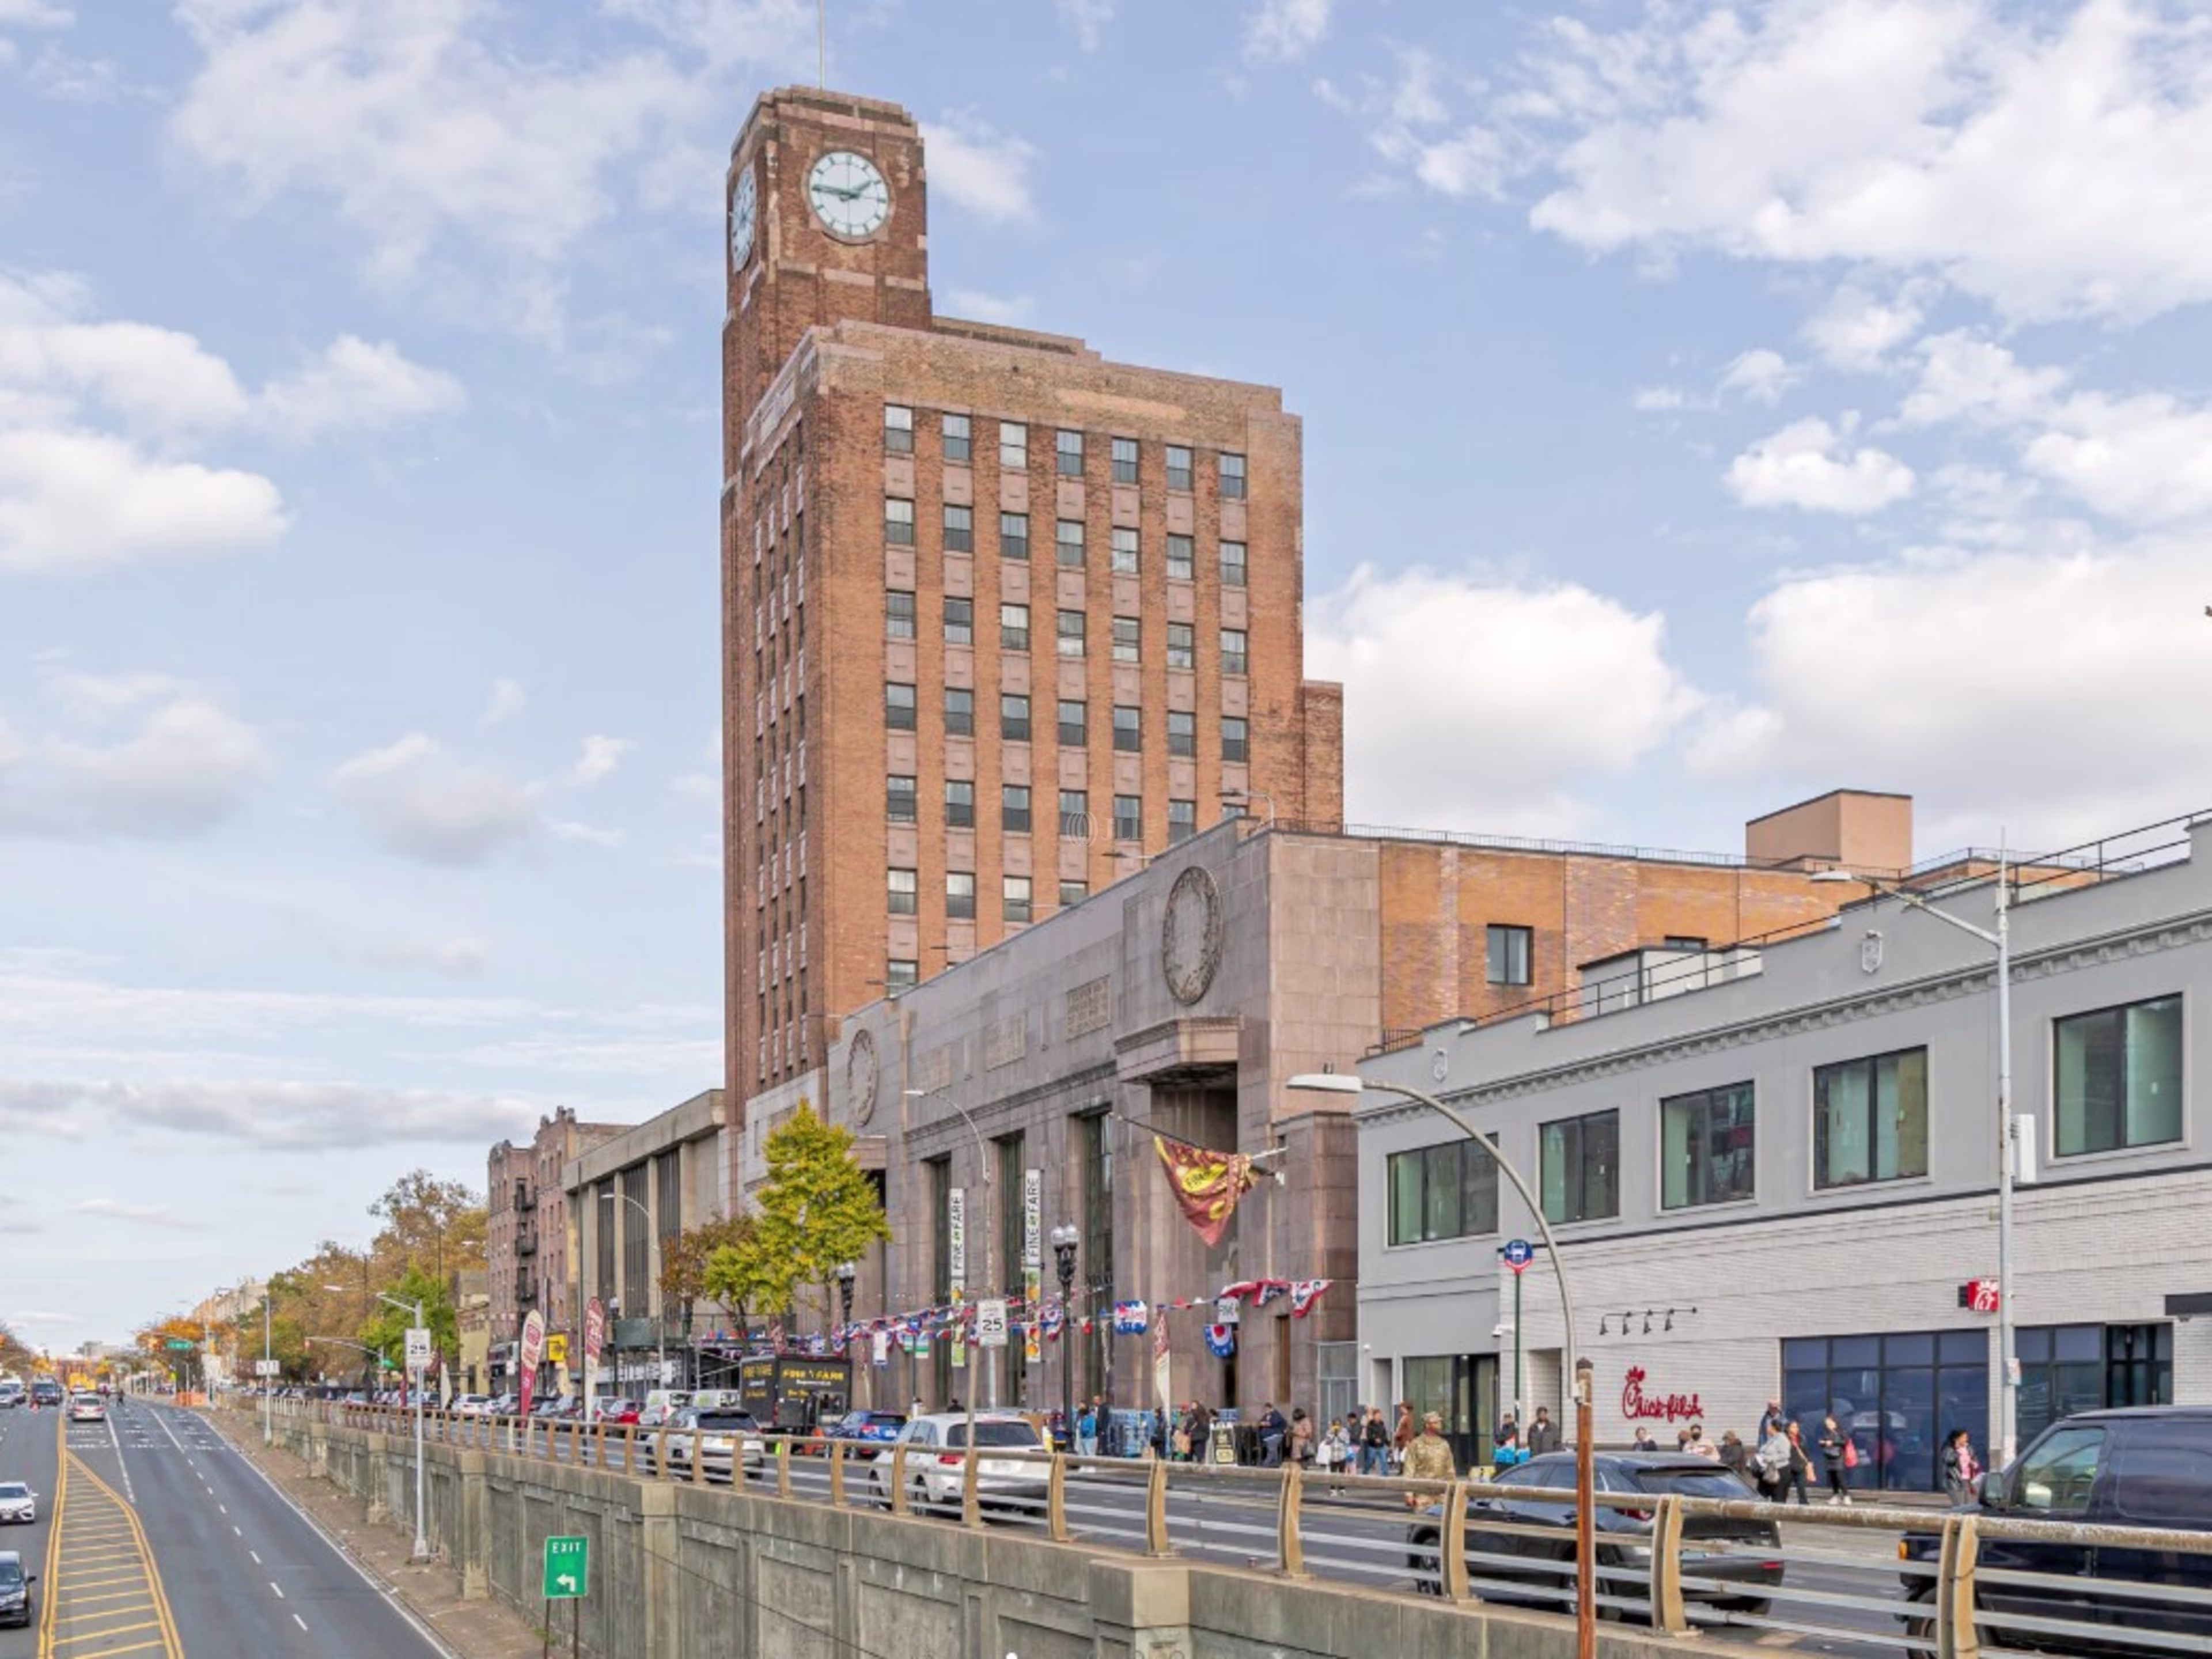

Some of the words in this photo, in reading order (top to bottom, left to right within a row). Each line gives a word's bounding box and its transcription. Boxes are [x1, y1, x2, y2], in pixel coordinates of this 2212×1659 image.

[1028, 1178, 1039, 1213] FARE
[952, 1196, 962, 1229] FARE
[952, 1243, 962, 1270] FINE
[1028, 1228, 1039, 1257] FINE
[982, 1317, 1003, 1332] 25
[552, 1542, 581, 1554] EXIT
